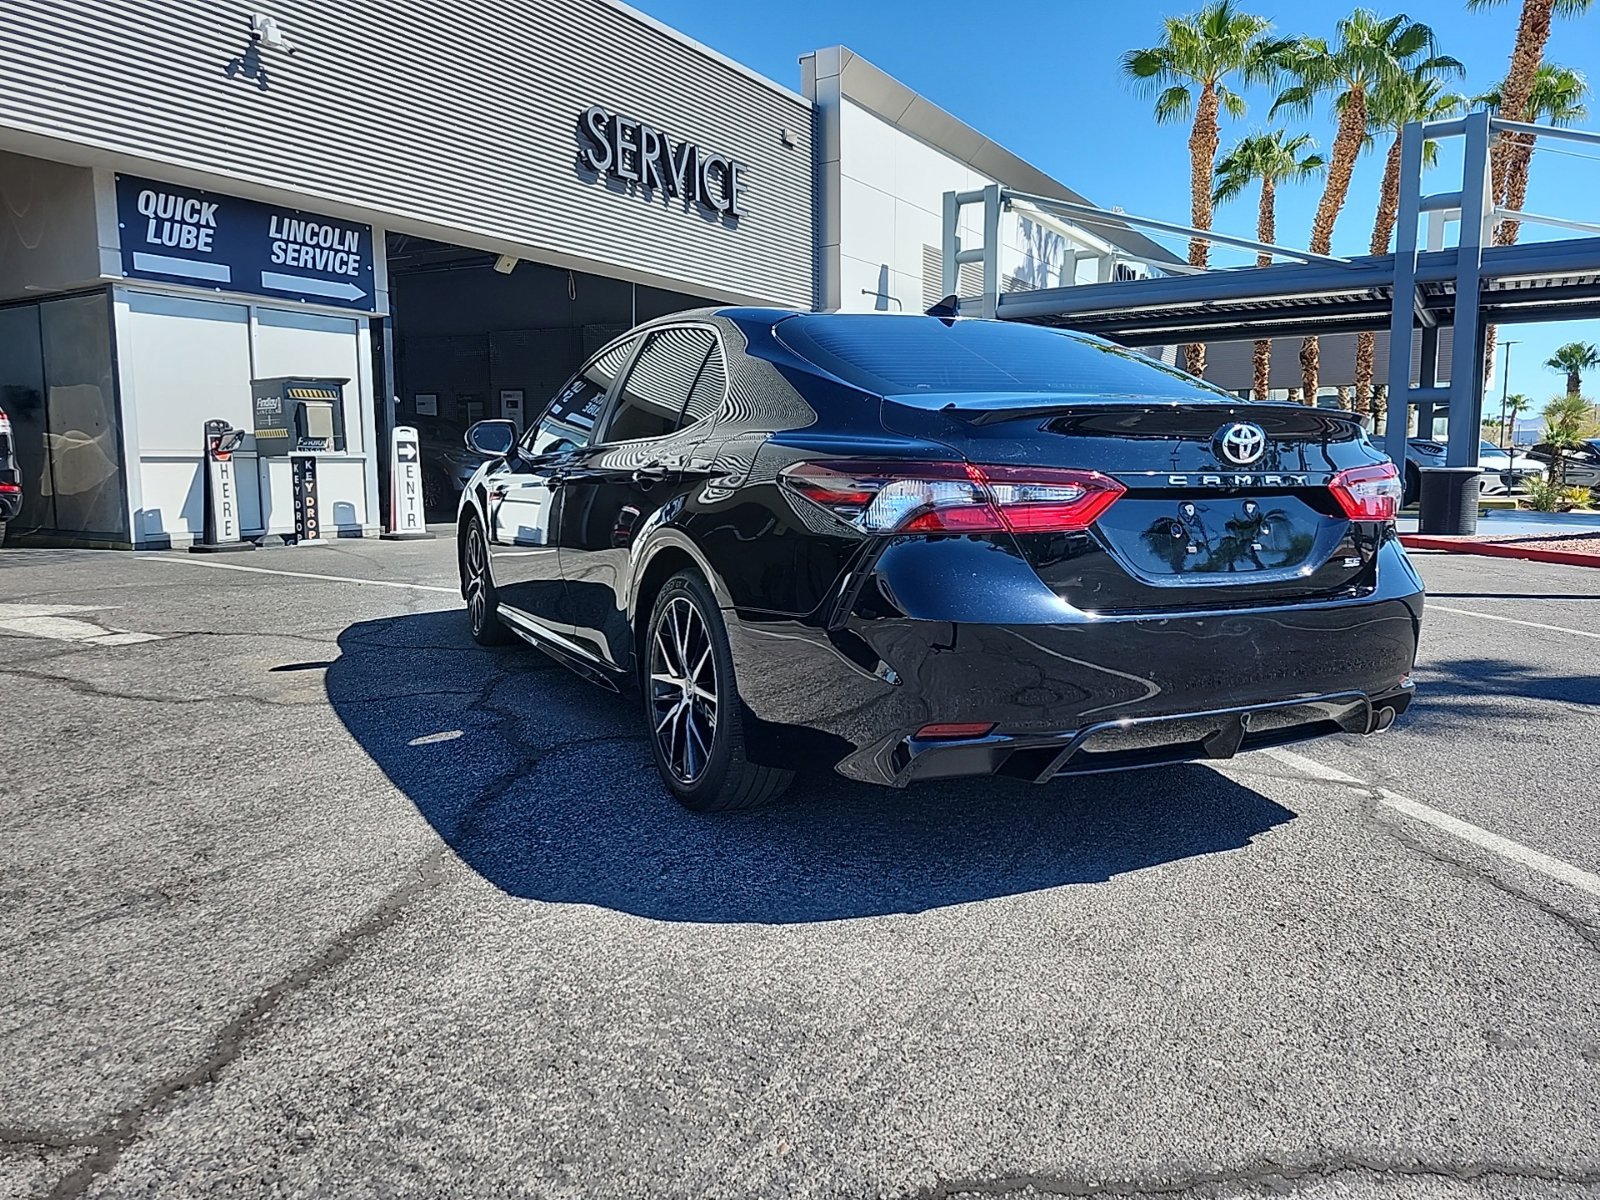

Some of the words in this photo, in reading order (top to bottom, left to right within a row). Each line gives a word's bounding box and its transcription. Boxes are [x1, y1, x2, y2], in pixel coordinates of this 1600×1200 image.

[578, 104, 749, 218] SERVICE
[137, 190, 219, 228] QUICK
[146, 219, 214, 253] LUBE
[268, 215, 360, 253] LINCOLN
[271, 241, 361, 276] SERVICE
[293, 463, 302, 495] KEY
[305, 460, 314, 493] KEY
[1168, 474, 1308, 486] CAMRY
[220, 463, 232, 536] HERE
[405, 465, 417, 528] ENTR
[295, 500, 304, 542] DROP
[306, 497, 317, 540] DROP
[1342, 557, 1361, 568] SE
